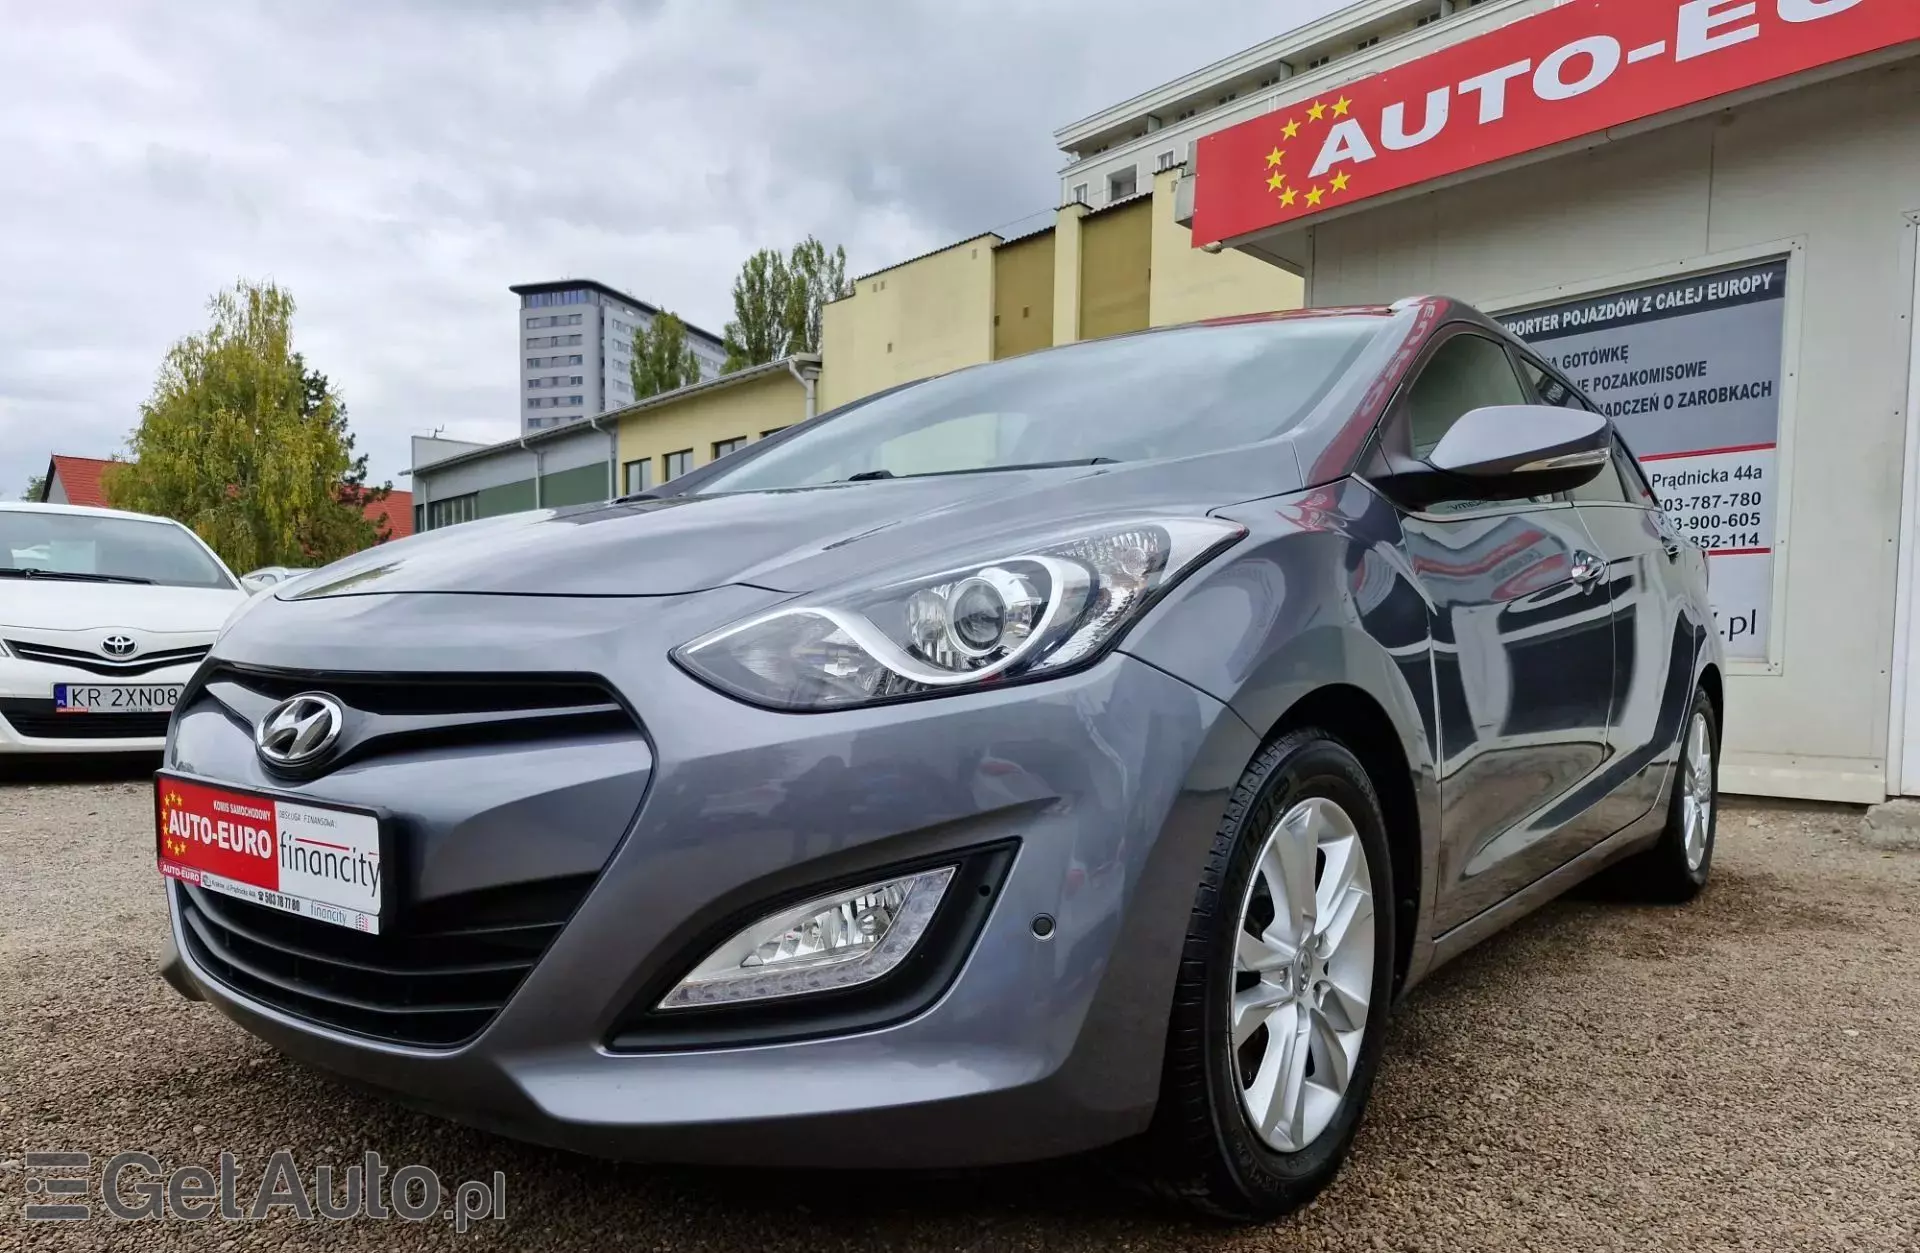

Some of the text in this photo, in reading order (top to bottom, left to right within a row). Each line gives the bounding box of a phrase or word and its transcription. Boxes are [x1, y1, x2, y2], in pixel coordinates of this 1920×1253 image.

[1503, 272, 1774, 336] PORTER POJAZDÓW Z CAŁEJ EUROPY
[1562, 345, 1629, 370] GOTÓWKĘ
[1593, 361, 1707, 392] POZAKOMISOWE
[1663, 395, 1674, 410] O
[1677, 380, 1773, 408] ZAROBKACH
[1651, 465, 1763, 490] Prądnicka 44a
[1658, 492, 1762, 512] 03-787-780
[1674, 512, 1761, 531] 3-900-605
[1690, 532, 1760, 549] 852-114
[1713, 608, 1756, 642] .pl
[72, 688, 178, 707] KR 2XN08
[169, 809, 272, 859] AUTO-EURO
[163, 864, 200, 882] AUTO-EURO
[280, 831, 381, 897] financity
[310, 899, 348, 926] financity
